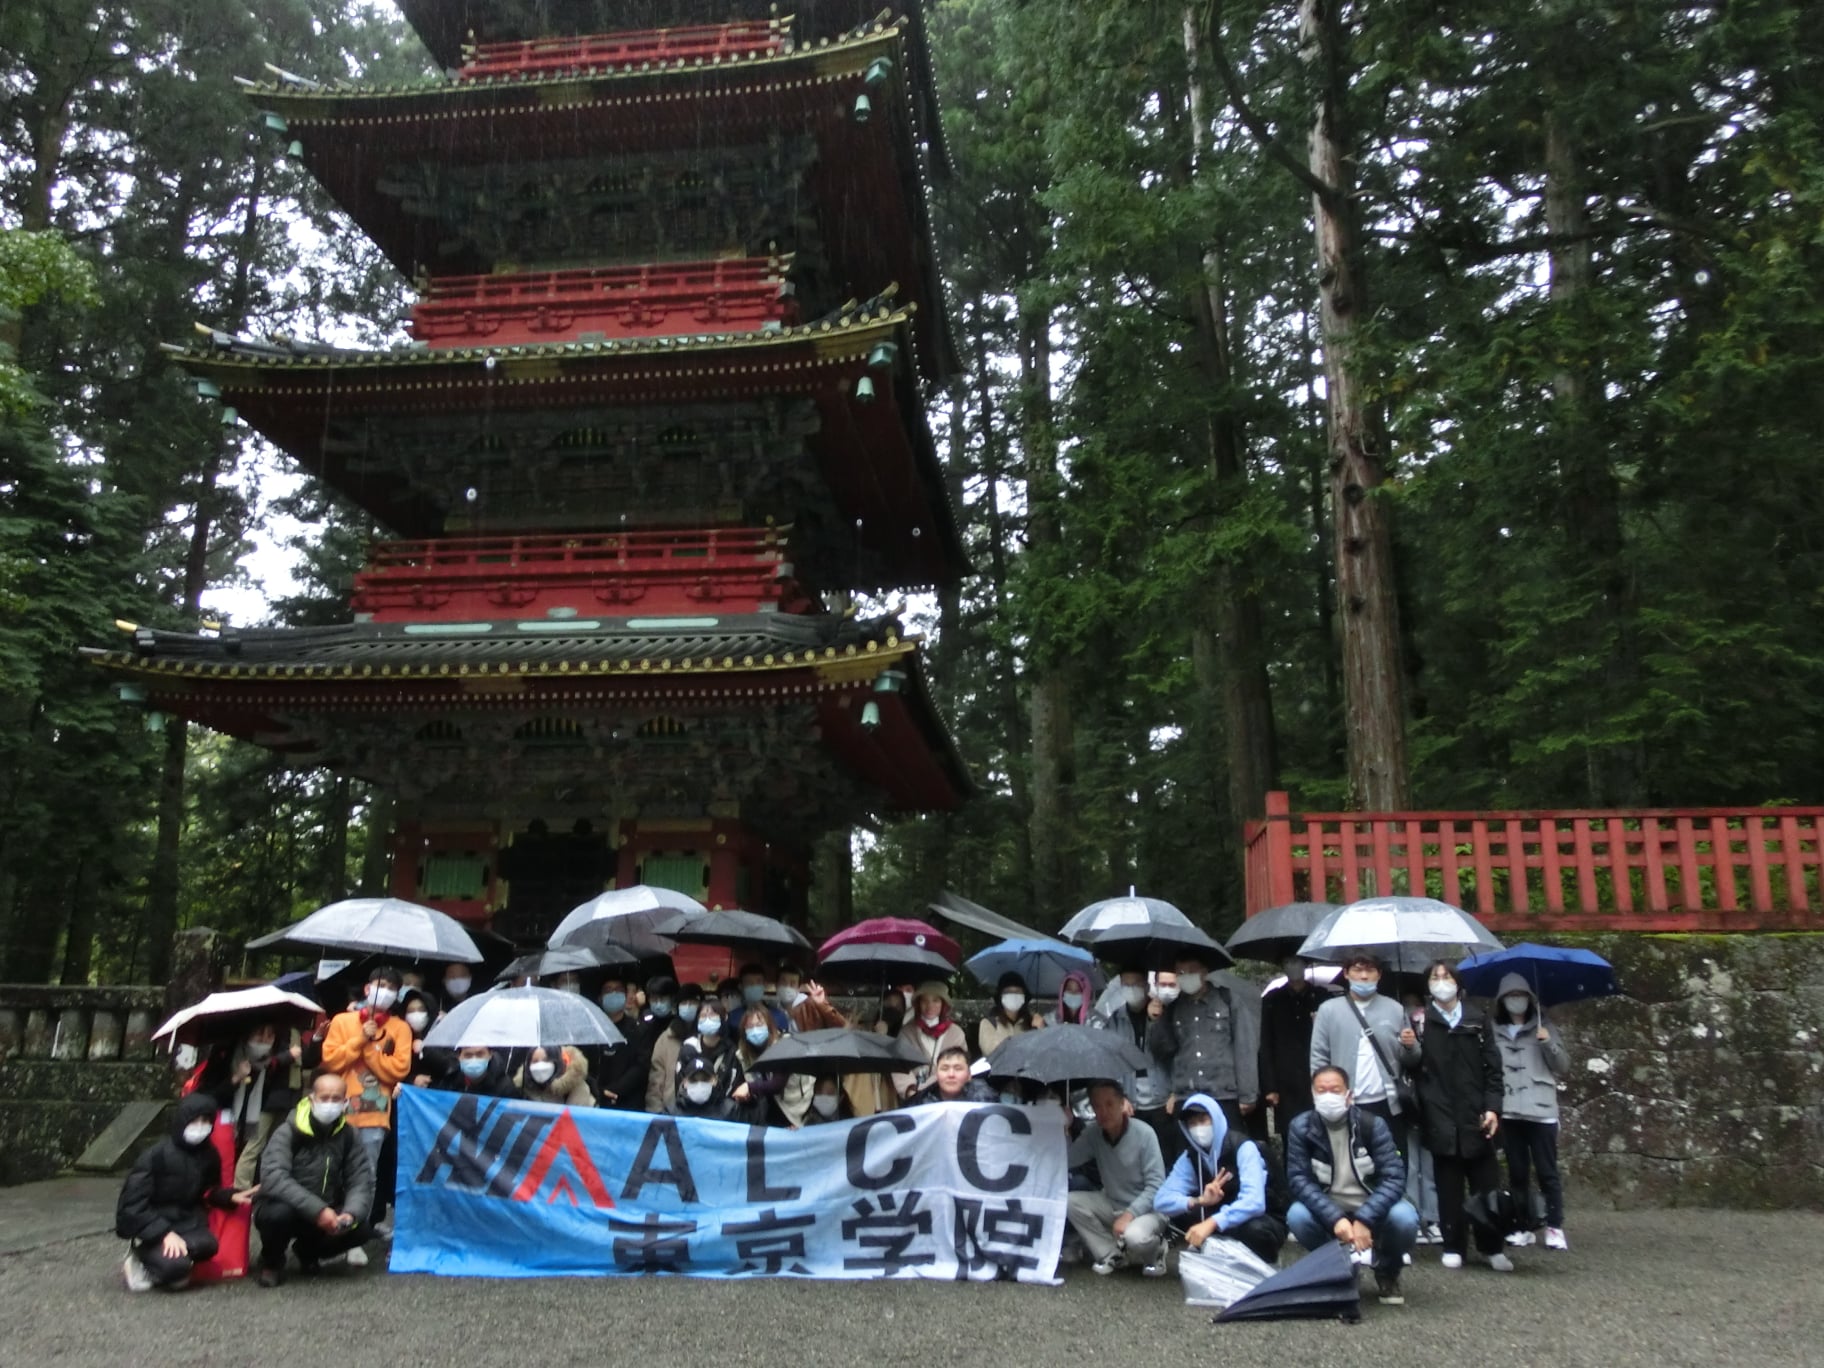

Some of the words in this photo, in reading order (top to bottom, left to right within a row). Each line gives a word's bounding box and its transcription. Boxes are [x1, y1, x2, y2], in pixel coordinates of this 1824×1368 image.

[620, 1106, 1032, 1202] ALCC
[608, 1191, 1044, 1281] 東京学院
